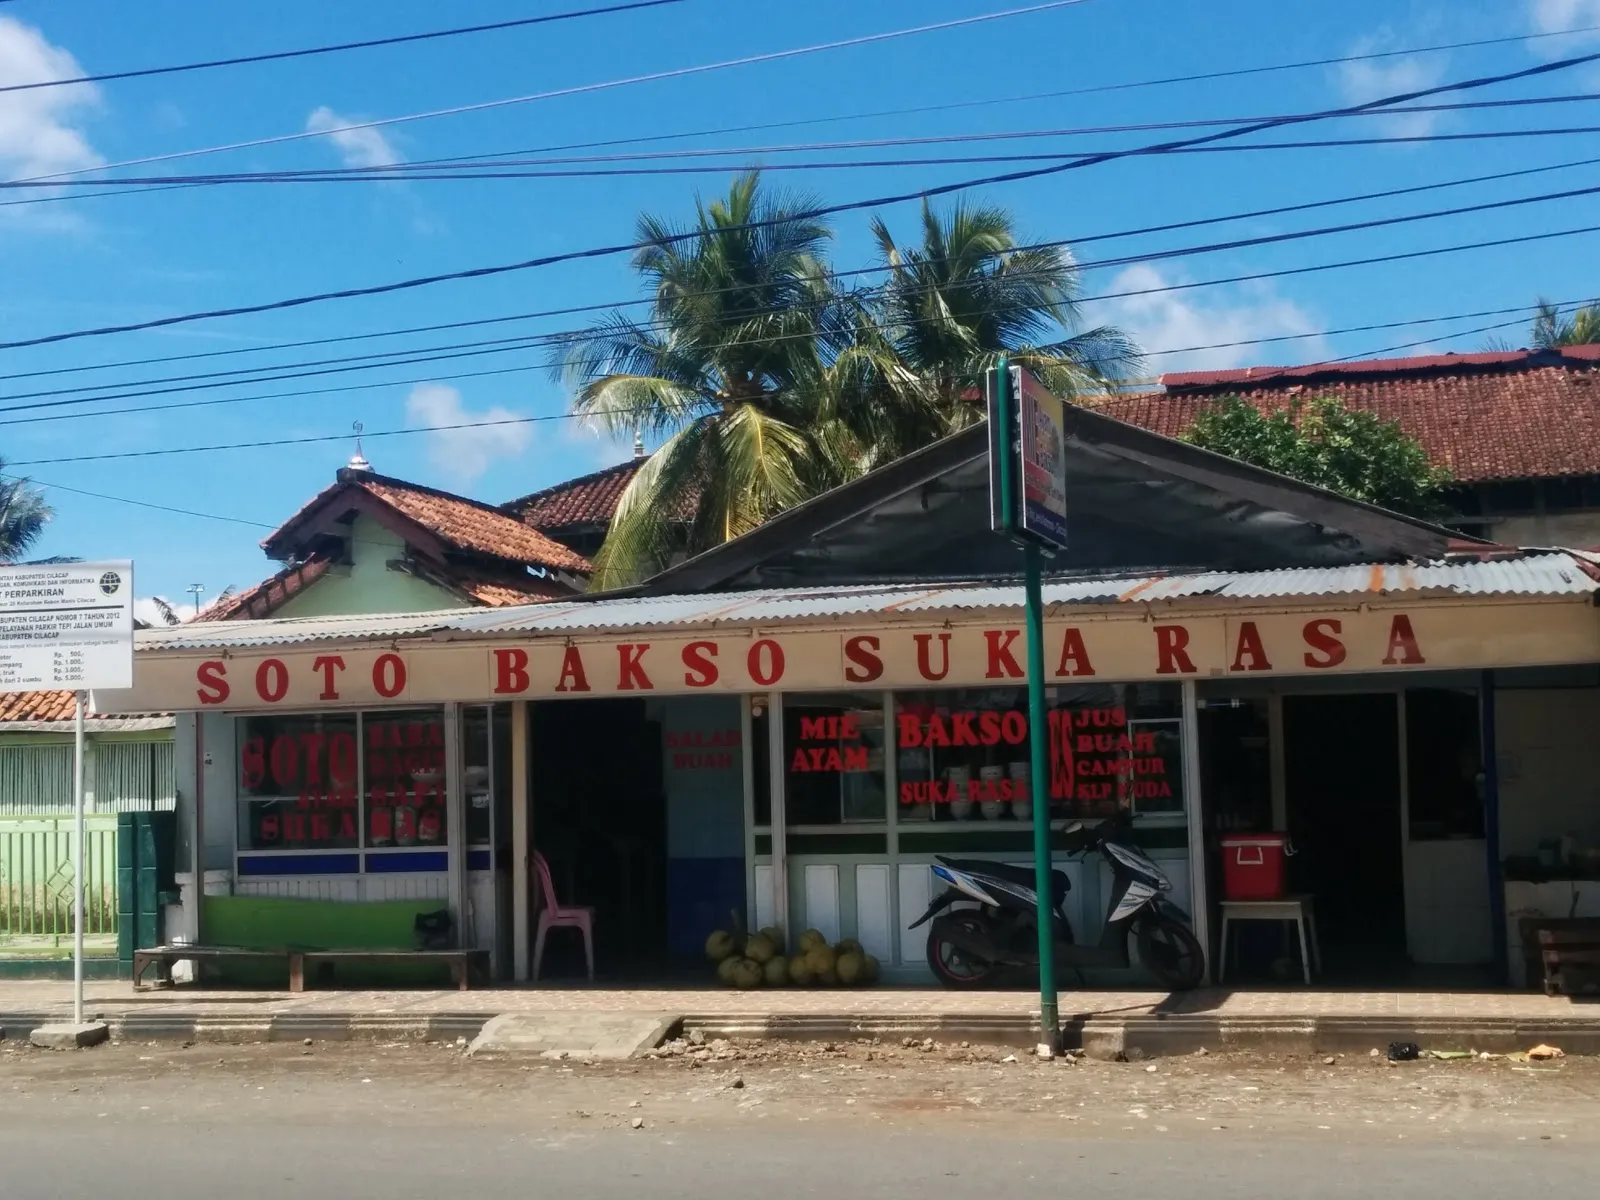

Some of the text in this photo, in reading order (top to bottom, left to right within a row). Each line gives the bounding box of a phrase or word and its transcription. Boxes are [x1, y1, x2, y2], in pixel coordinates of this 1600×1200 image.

[5, 588, 64, 598] PERPARKIRAN
[35, 623, 57, 631] PARKIR
[59, 622, 72, 630] TEPI
[196, 614, 1426, 704] SOTO BAKSO SUKA RASA
[800, 714, 861, 740] MIE
[1075, 707, 1127, 727] JUS
[898, 710, 1027, 748] BAKSO
[1077, 732, 1155, 753] BUAH
[242, 732, 356, 789] SOTO
[790, 745, 869, 772] AYAM
[1076, 757, 1166, 776] CAMPUR
[900, 777, 1028, 804] SUKA RASA
[1117, 780, 1172, 799] MUDA
